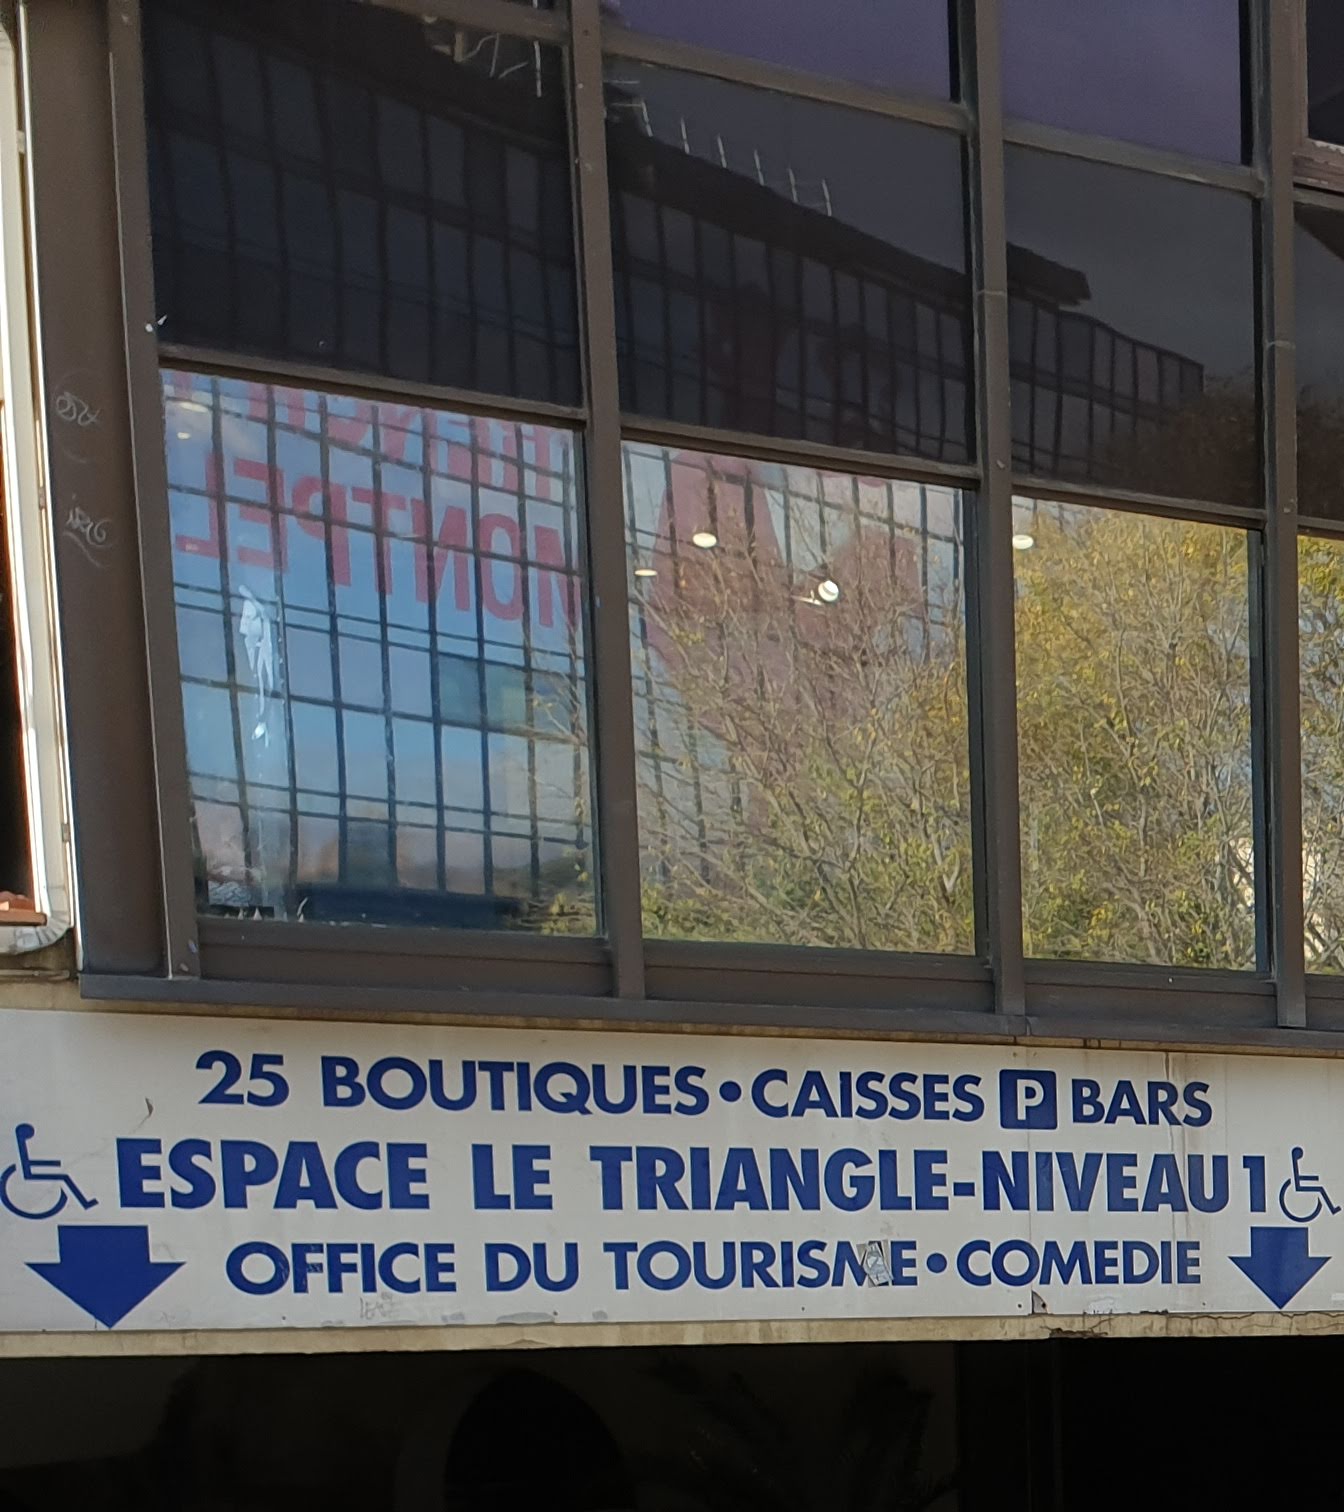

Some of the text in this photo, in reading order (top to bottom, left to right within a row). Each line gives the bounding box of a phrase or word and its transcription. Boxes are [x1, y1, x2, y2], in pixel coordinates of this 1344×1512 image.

[195, 1050, 290, 1107] 25
[1071, 1078, 1213, 1128] BARS
[116, 1137, 430, 1210] ESPACE
[471, 1144, 553, 1210] LE
[1242, 1154, 1266, 1213] 1
[225, 1240, 457, 1295] OFFICE
[484, 1242, 580, 1292] DU
[956, 1238, 1201, 1287] COMEDIE
